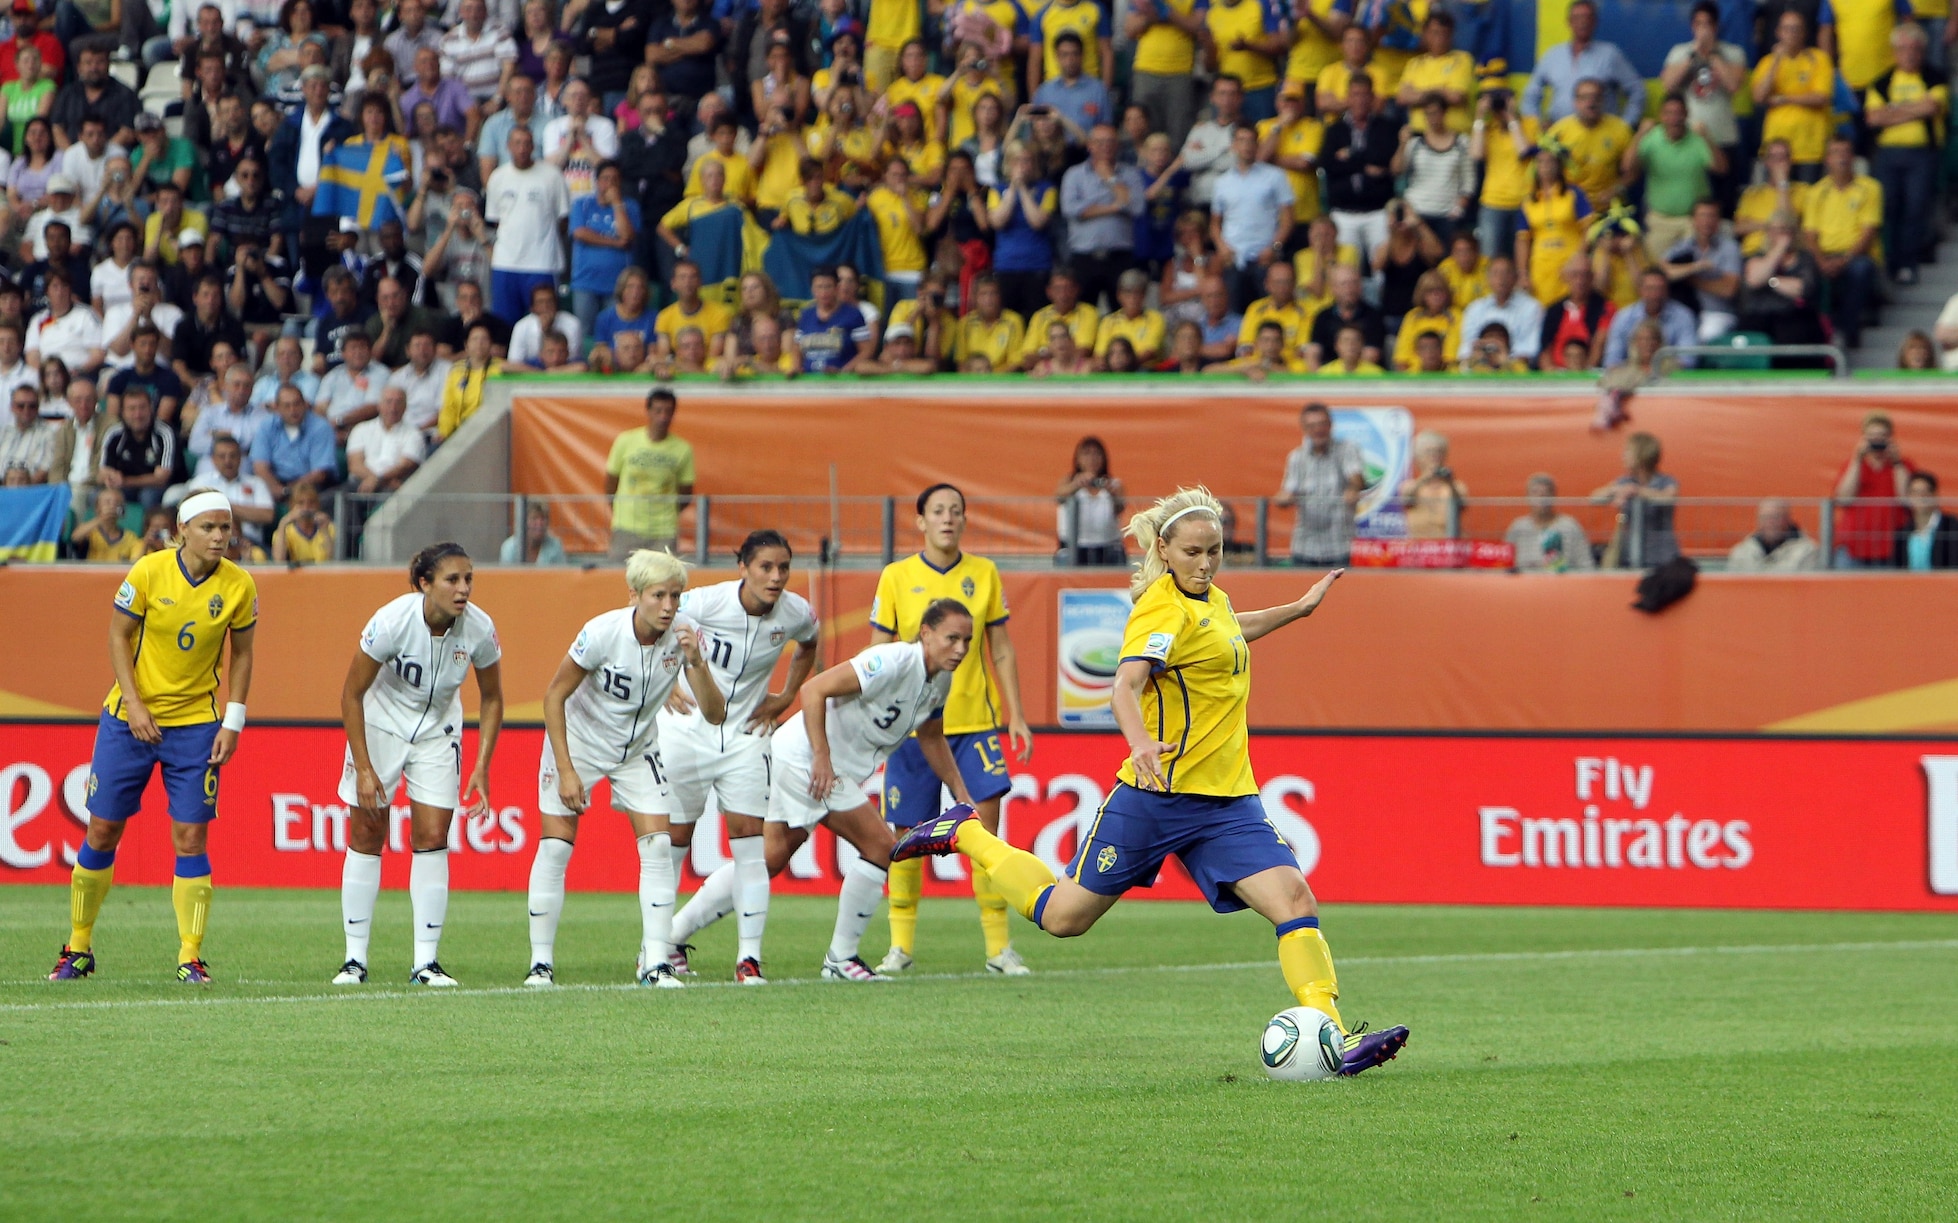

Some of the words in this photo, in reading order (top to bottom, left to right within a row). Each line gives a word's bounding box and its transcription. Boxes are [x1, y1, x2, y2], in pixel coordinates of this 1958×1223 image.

[177, 621, 196, 651] 6
[711, 638, 732, 669] 11
[1229, 635, 1247, 675] 17
[394, 656, 422, 688] 10
[603, 668, 632, 701] 15
[873, 705, 901, 730] 3
[203, 765, 218, 797] 6
[1574, 756, 1654, 809] Fly
[271, 792, 527, 853] Emrtes
[1478, 804, 1754, 869] Emirates
